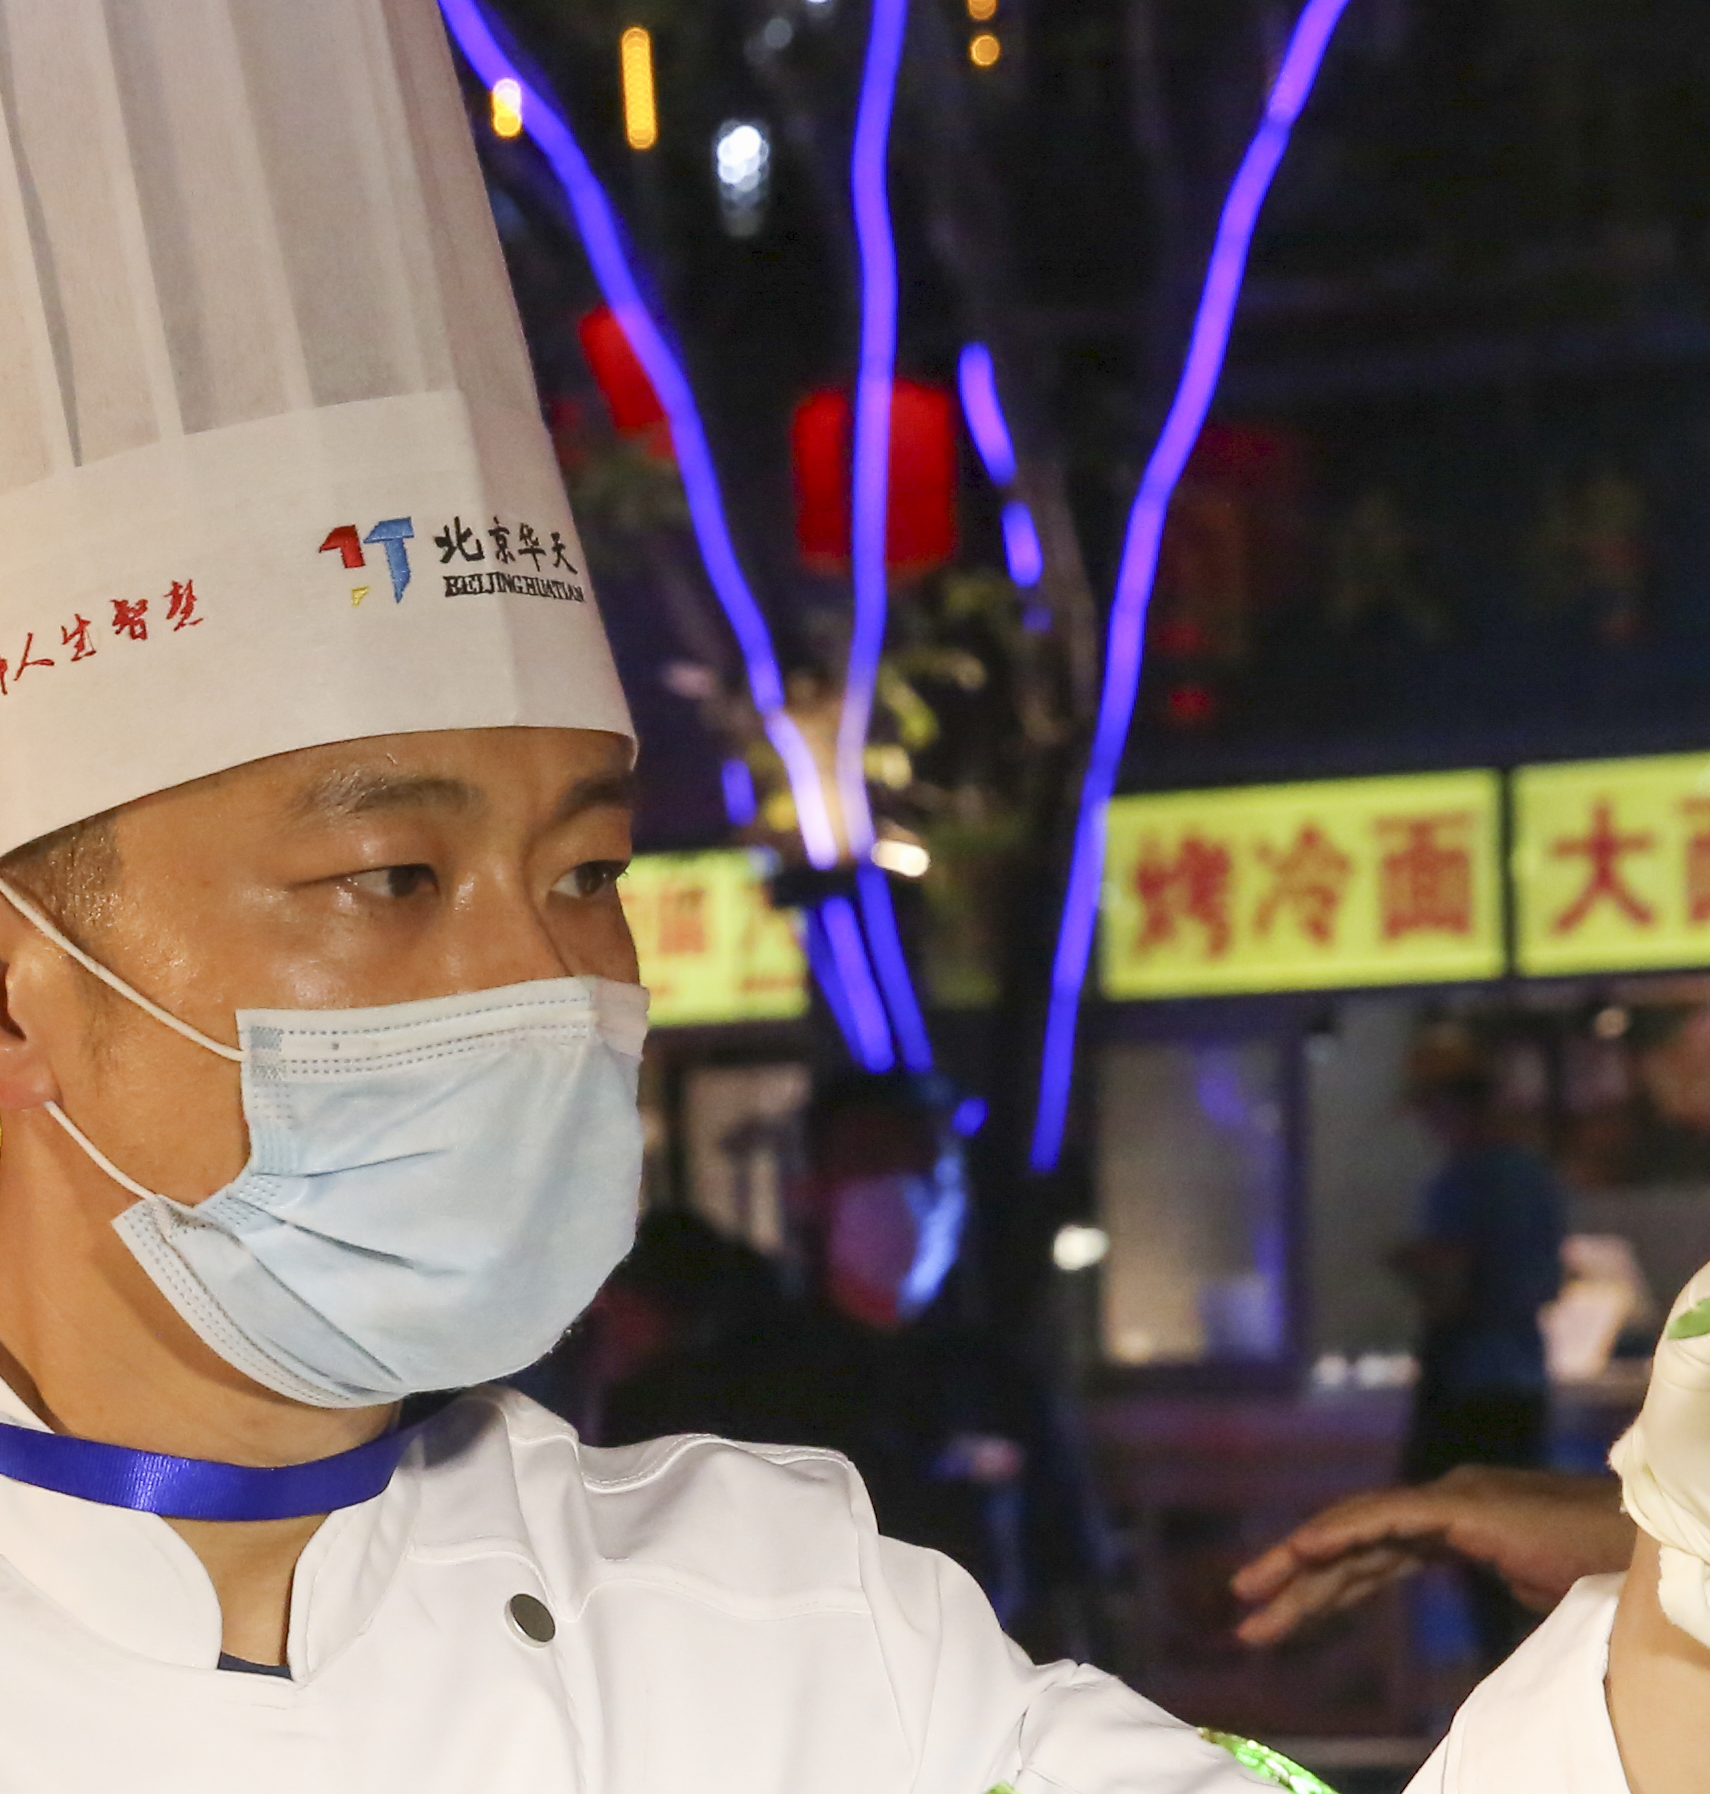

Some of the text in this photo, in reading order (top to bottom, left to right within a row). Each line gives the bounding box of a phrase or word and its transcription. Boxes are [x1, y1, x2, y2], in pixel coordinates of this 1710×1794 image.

[434, 515, 579, 575] 北京华天
[1130, 808, 1476, 962] 烤冷面
